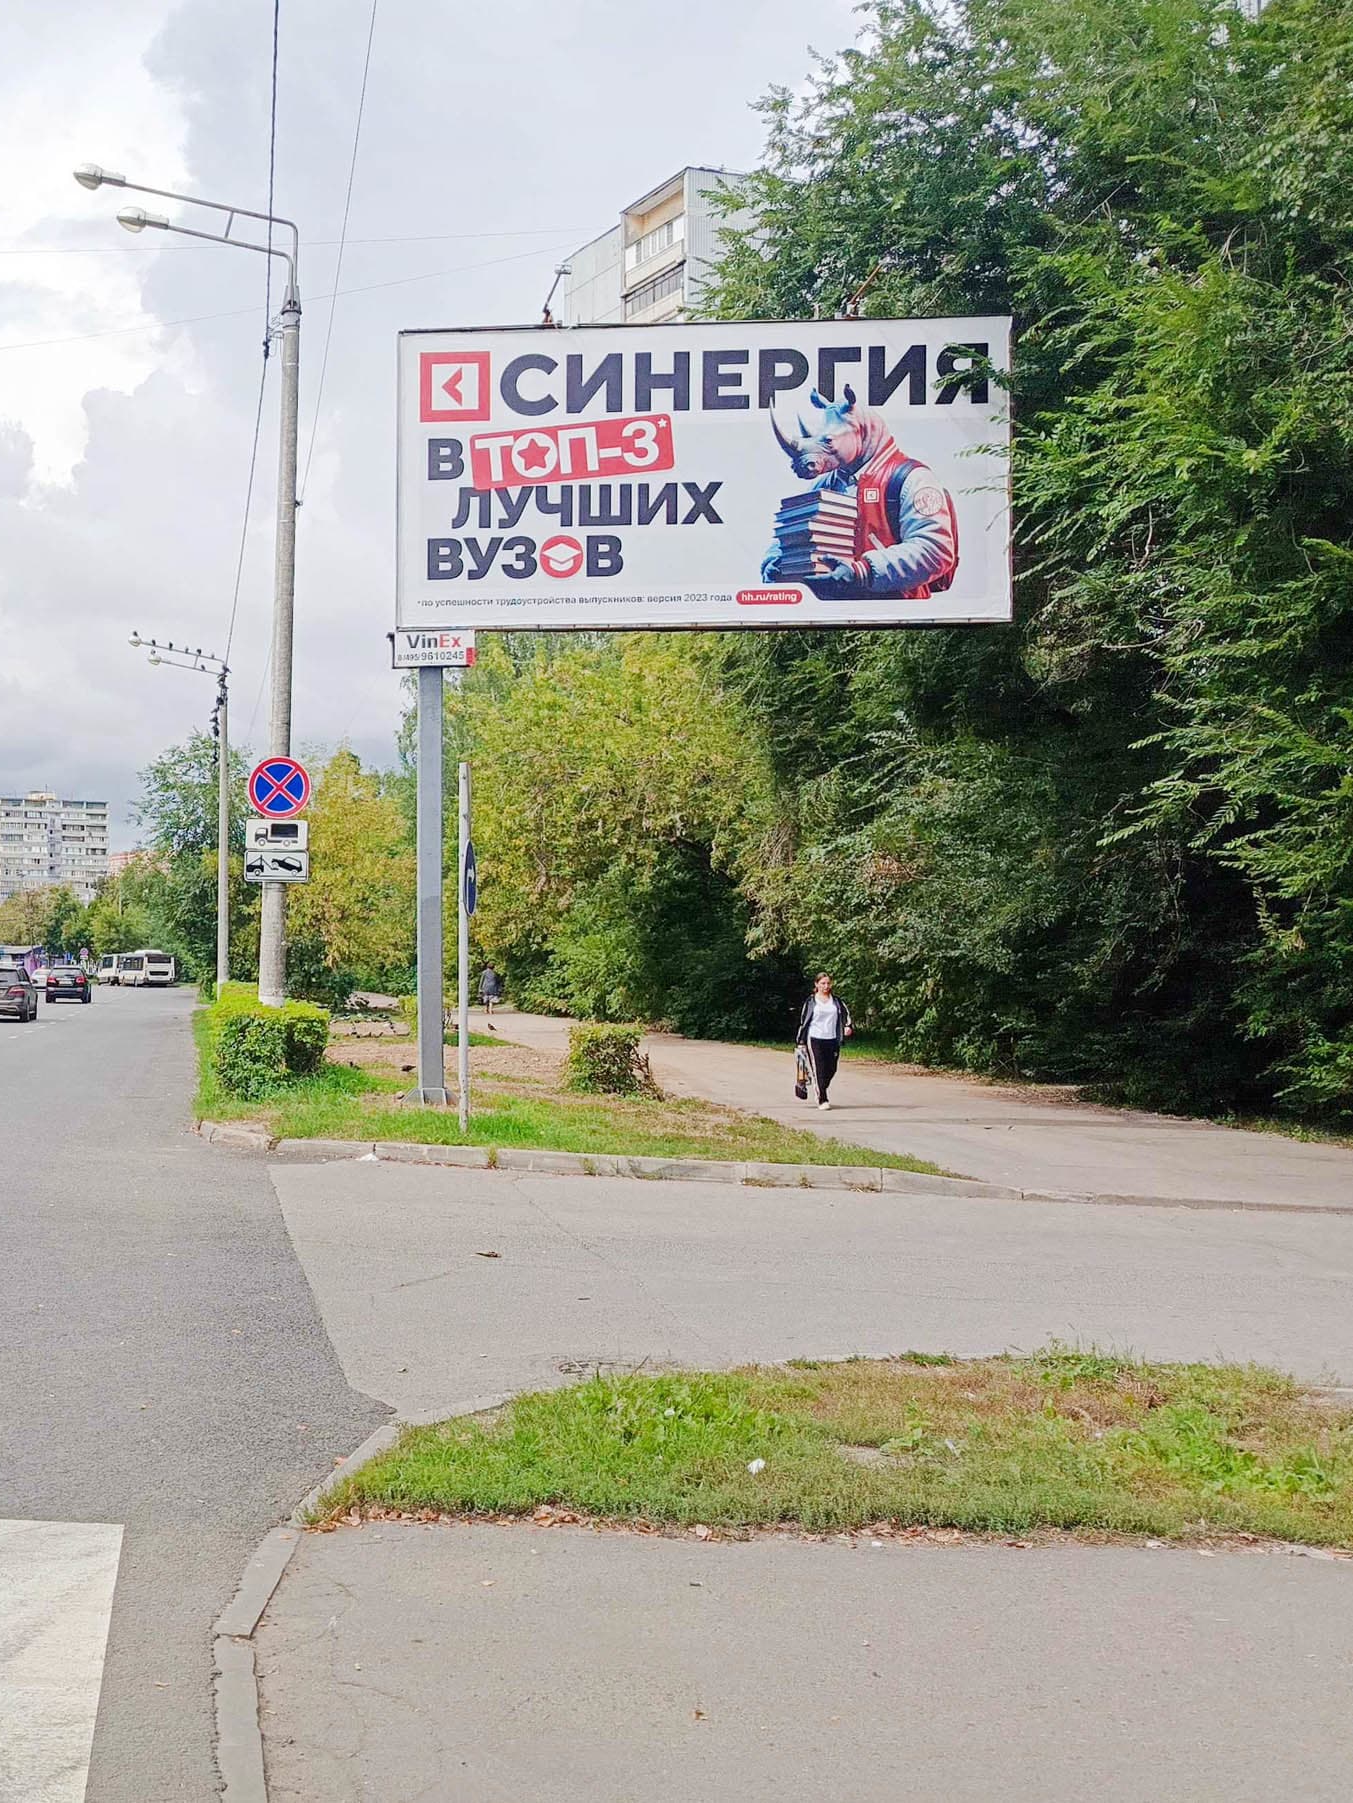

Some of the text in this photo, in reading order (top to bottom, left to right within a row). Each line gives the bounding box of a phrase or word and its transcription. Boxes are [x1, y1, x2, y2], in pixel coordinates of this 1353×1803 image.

[500, 342, 989, 417] СИНЕРГИЯ
[451, 481, 724, 529] ЛУЧШИХ
[427, 535, 624, 580] ВУЗОВ
[435, 598, 494, 609] успешности
[495, 596, 577, 607] трудоустройства
[647, 593, 682, 605] версия
[684, 592, 708, 602] 2023
[710, 594, 733, 602] года
[741, 591, 797, 603] hh.ru/rating
[406, 633, 462, 649] VinEx
